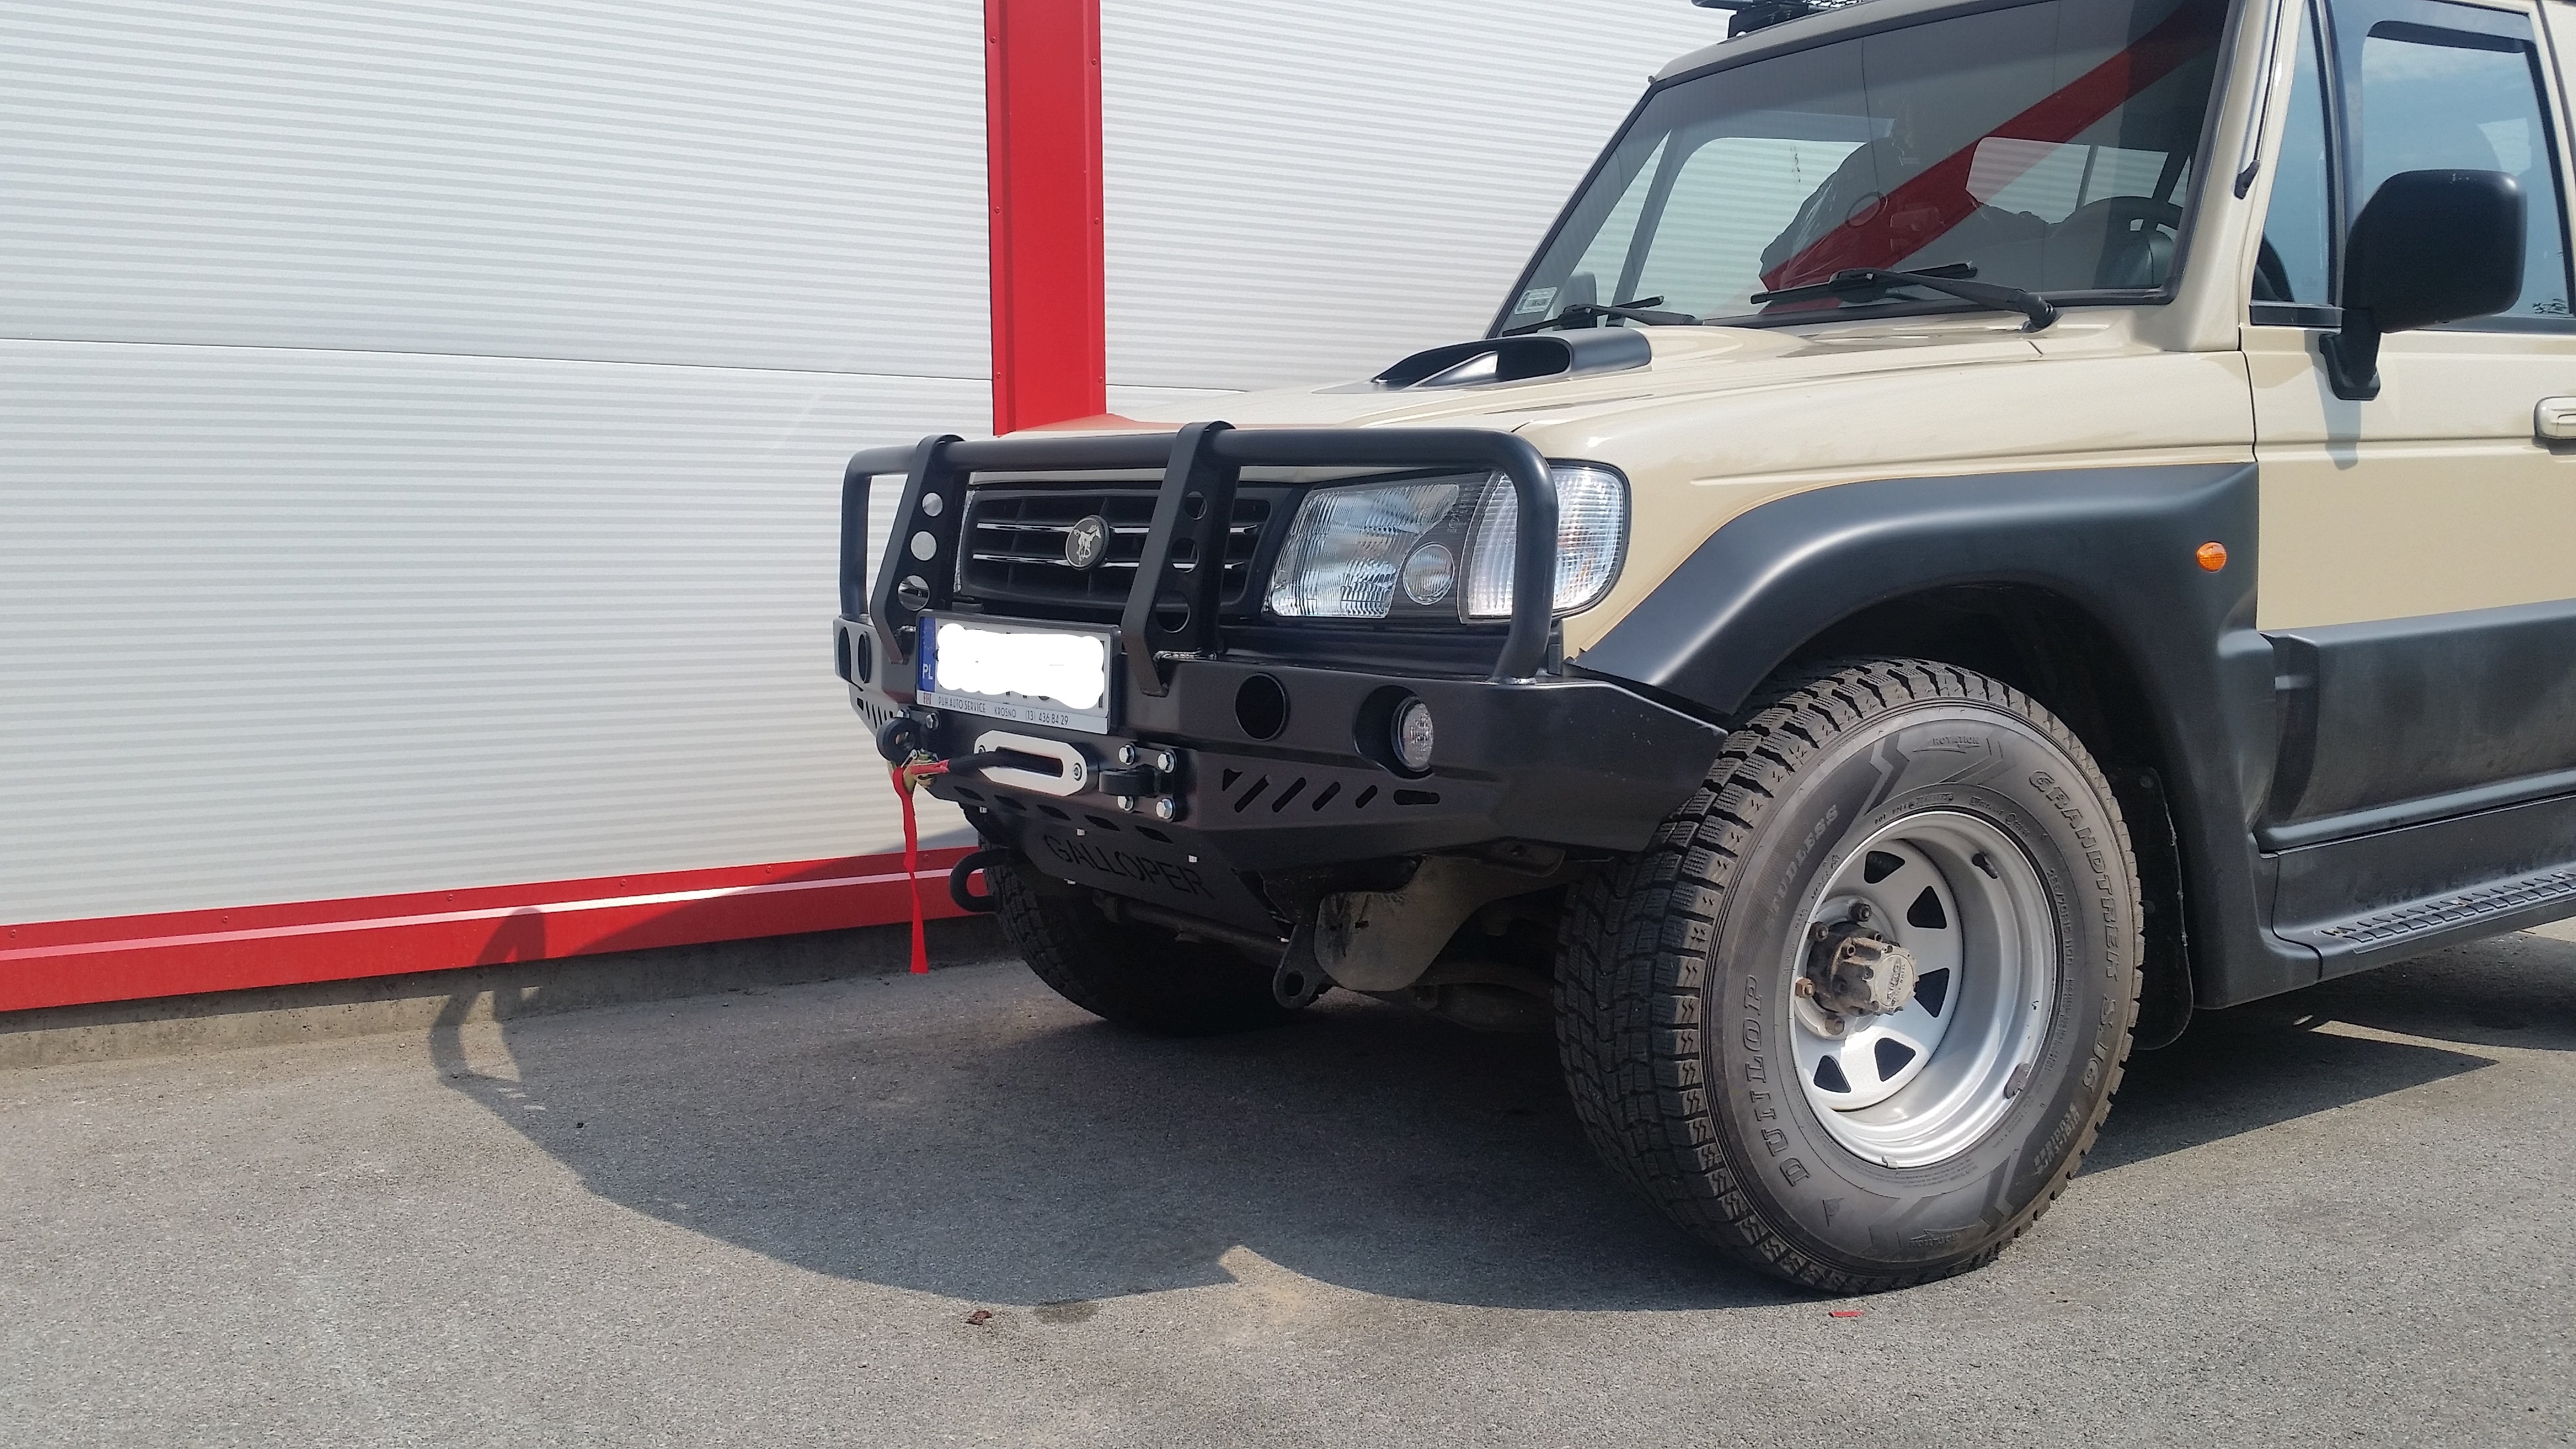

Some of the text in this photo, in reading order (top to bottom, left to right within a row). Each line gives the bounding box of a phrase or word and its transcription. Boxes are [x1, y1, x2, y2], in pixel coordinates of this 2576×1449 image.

[922, 663, 934, 680] PL
[950, 698, 964, 709] AUTO
[965, 700, 986, 713] SERVICE
[995, 707, 1016, 718] KROSNO
[1026, 710, 1036, 721] (13)
[1039, 712, 1050, 723] 436
[1051, 713, 1059, 724] 84
[1061, 715, 1069, 725] 29
[1933, 736, 1980, 746] ROTATION
[1043, 834, 1217, 899] GALLOPER
[2029, 770, 2120, 982] GRANDTREK
[2082, 993, 2116, 1094] SJ6
[1742, 975, 1811, 1187] DUNLOP
